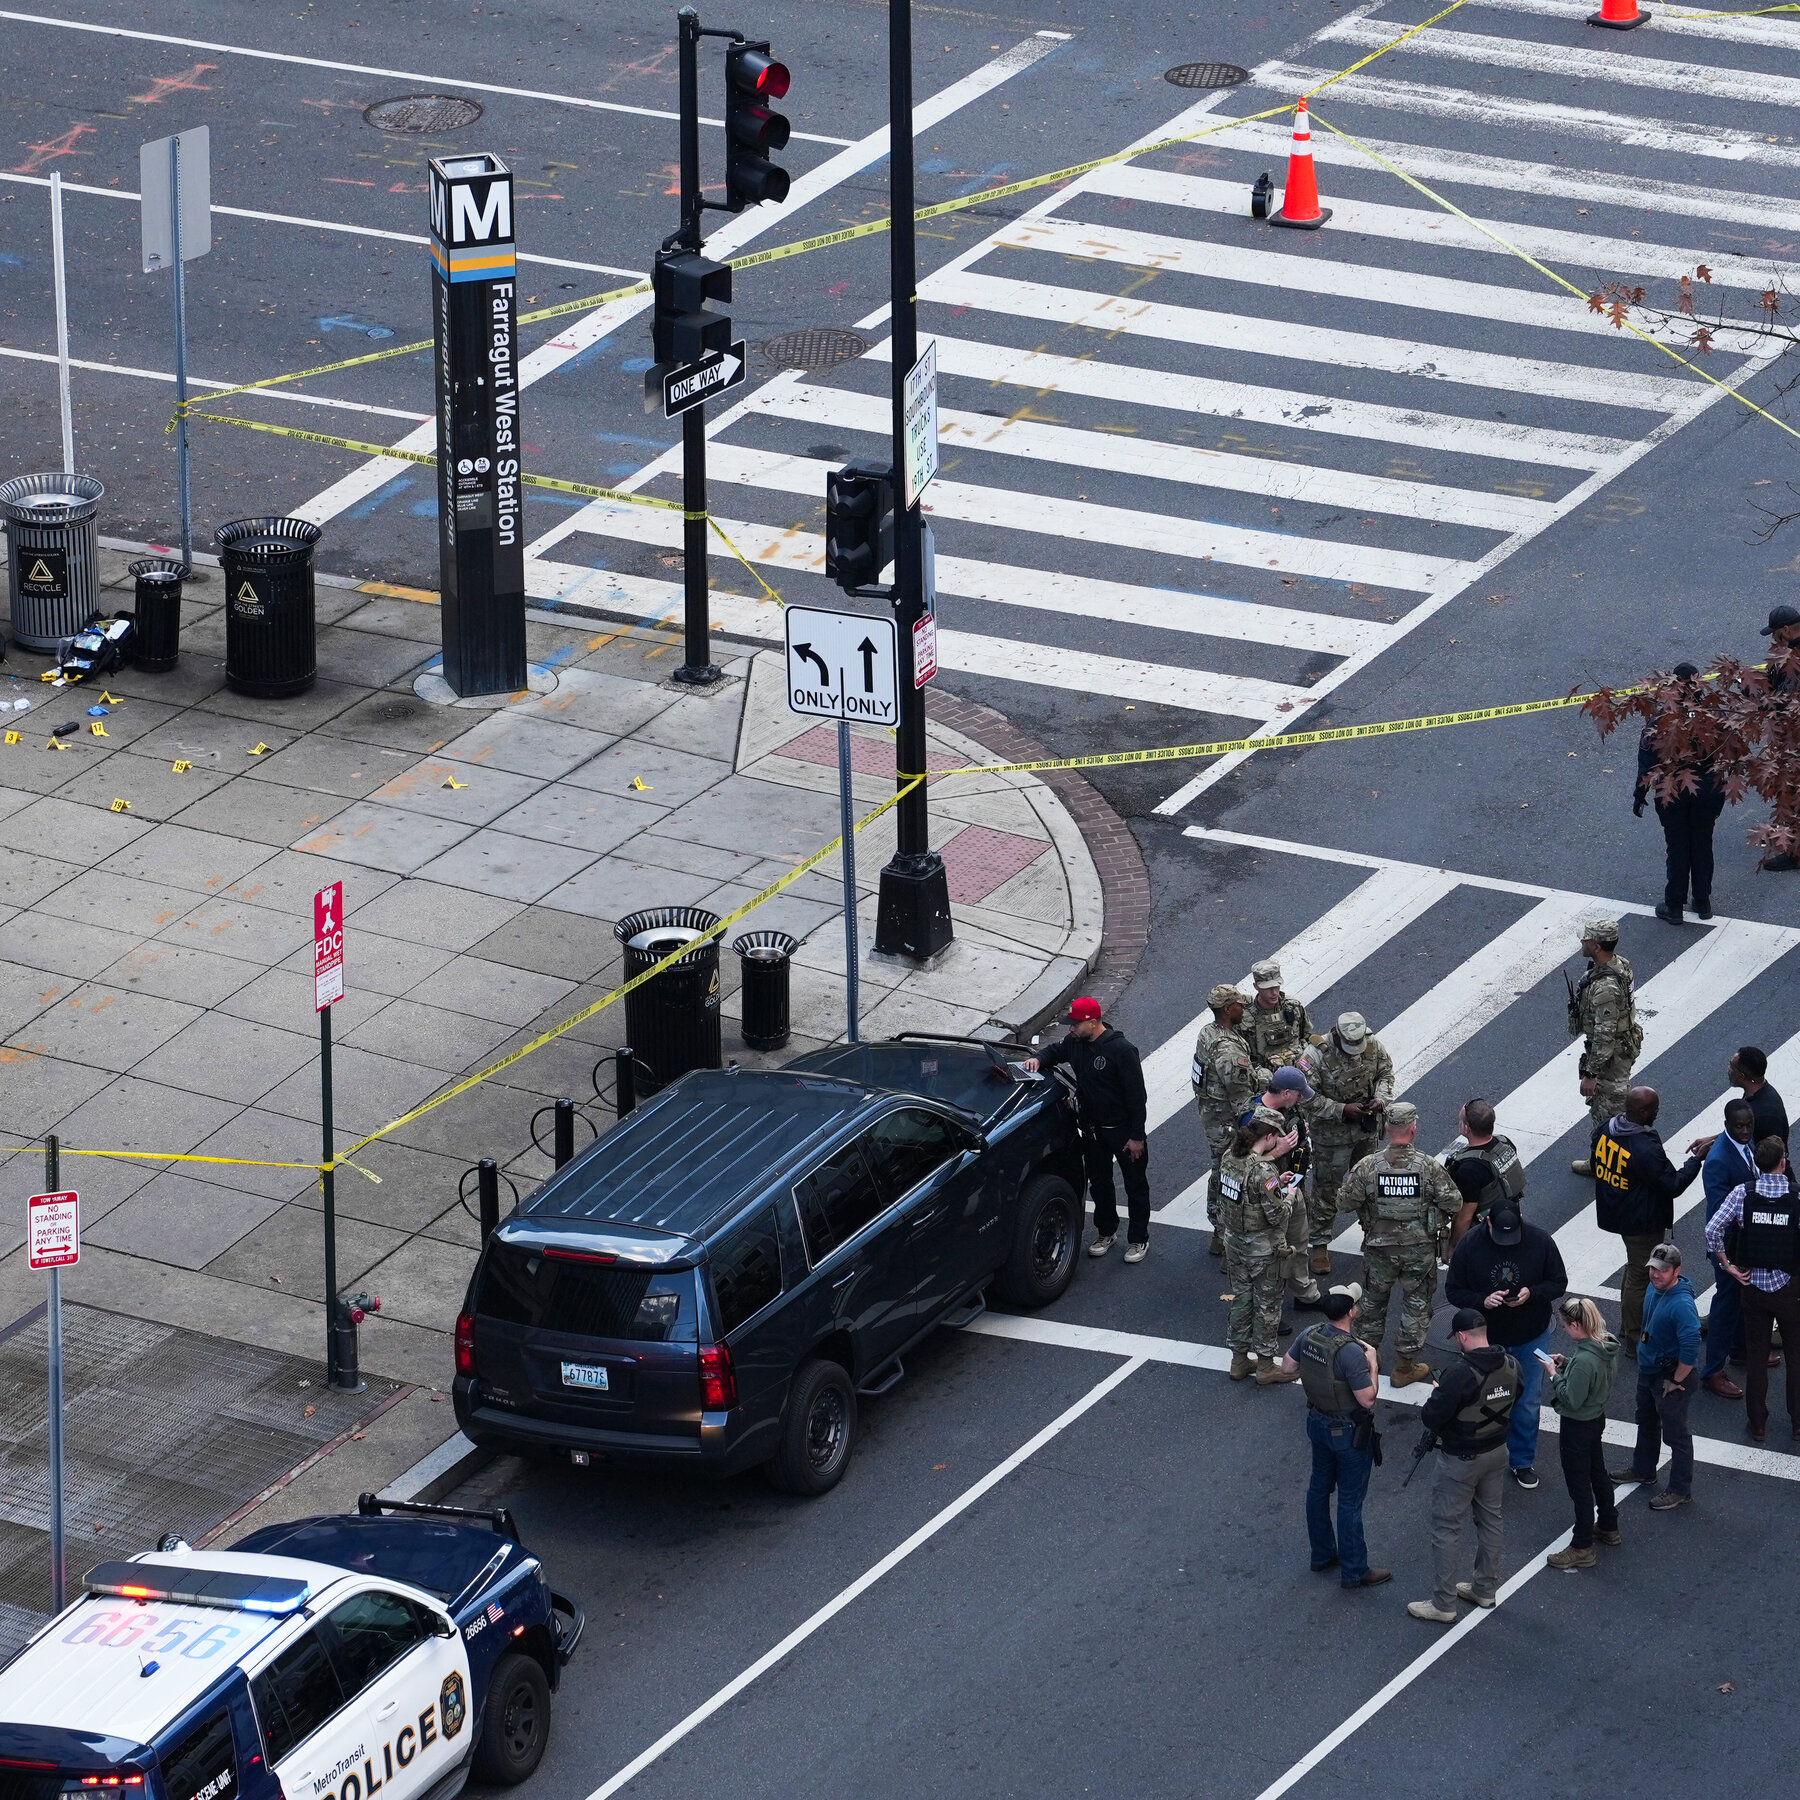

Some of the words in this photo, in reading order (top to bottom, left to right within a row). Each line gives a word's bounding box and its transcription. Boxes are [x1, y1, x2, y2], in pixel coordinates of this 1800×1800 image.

[430, 168, 446, 241] M
[451, 180, 511, 242] M
[831, 233, 841, 242] LINE
[840, 229, 856, 239] POLICE
[802, 239, 816, 250] CROSS
[815, 237, 825, 246] NOT
[824, 235, 831, 244] DO
[488, 283, 513, 387] Farragut
[925, 356, 931, 376] ST
[674, 377, 695, 400] ONE
[699, 363, 721, 388] WAY
[495, 390, 517, 452] West
[911, 406, 931, 443] TRUCKS
[917, 436, 926, 461] USE
[426, 456, 438, 465] CROS
[926, 453, 933, 474] ST
[521, 474, 537, 484] CROSS
[446, 462, 454, 546] Station
[496, 459, 519, 546] Station
[23, 582, 61, 592] RECYCLE
[234, 603, 265, 615] GOLDEN
[794, 689, 839, 710] ONLY
[847, 696, 892, 717] ONLY
[1404, 720, 1413, 728] NOT
[1425, 717, 1436, 725] LINE
[1436, 715, 1453, 724] POLICE
[93, 723, 102, 732] 17
[1355, 726, 1366, 734] LINE
[1367, 724, 1384, 733] POLICE
[1387, 722, 1404, 730] CROSS
[1318, 730, 1335, 739] CROSS
[1334, 729, 1344, 737] NOT
[1345, 728, 1352, 736] DO
[1264, 737, 1274, 746] NOT
[1275, 736, 1282, 744] DO
[1286, 735, 1297, 743] LINE
[1297, 733, 1315, 742] POLICE
[1216, 743, 1227, 751] LINE
[1228, 741, 1245, 750] POLICE
[1248, 739, 1264, 748] CROSS
[1134, 752, 1141, 760] DO
[1144, 751, 1156, 759] LINE
[1157, 749, 1174, 758] POLICE
[1177, 747, 1194, 755] CROSS
[1106, 754, 1123, 763] CROSS
[1123, 753, 1133, 761] NOT
[114, 801, 122, 809] 19
[316, 931, 342, 960] FDC
[705, 993, 720, 1007] GOLD
[1595, 1134, 1631, 1174] ATF
[1221, 1173, 1241, 1192] NATIONAL
[1379, 1175, 1419, 1187] NATIONAL
[1221, 1185, 1238, 1200] GUARD
[1383, 1186, 1415, 1196] GUARD
[47, 1205, 59, 1213] NO
[35, 1212, 72, 1223] STANDING
[1752, 1211, 1772, 1224] FEDERAL
[1773, 1213, 1789, 1226] AGENT
[37, 1226, 71, 1237] PARKING
[35, 1237, 52, 1246] ANY
[55, 1234, 73, 1243] TIME
[1487, 1390, 1511, 1400] MARSHAL
[465, 1615, 487, 1640] 26656
[61, 1612, 241, 1659] 6656
[321, 1702, 437, 1800] OLICE
[313, 1743, 365, 1795] MetroTransit
[216, 1768, 231, 1790] UNIT
